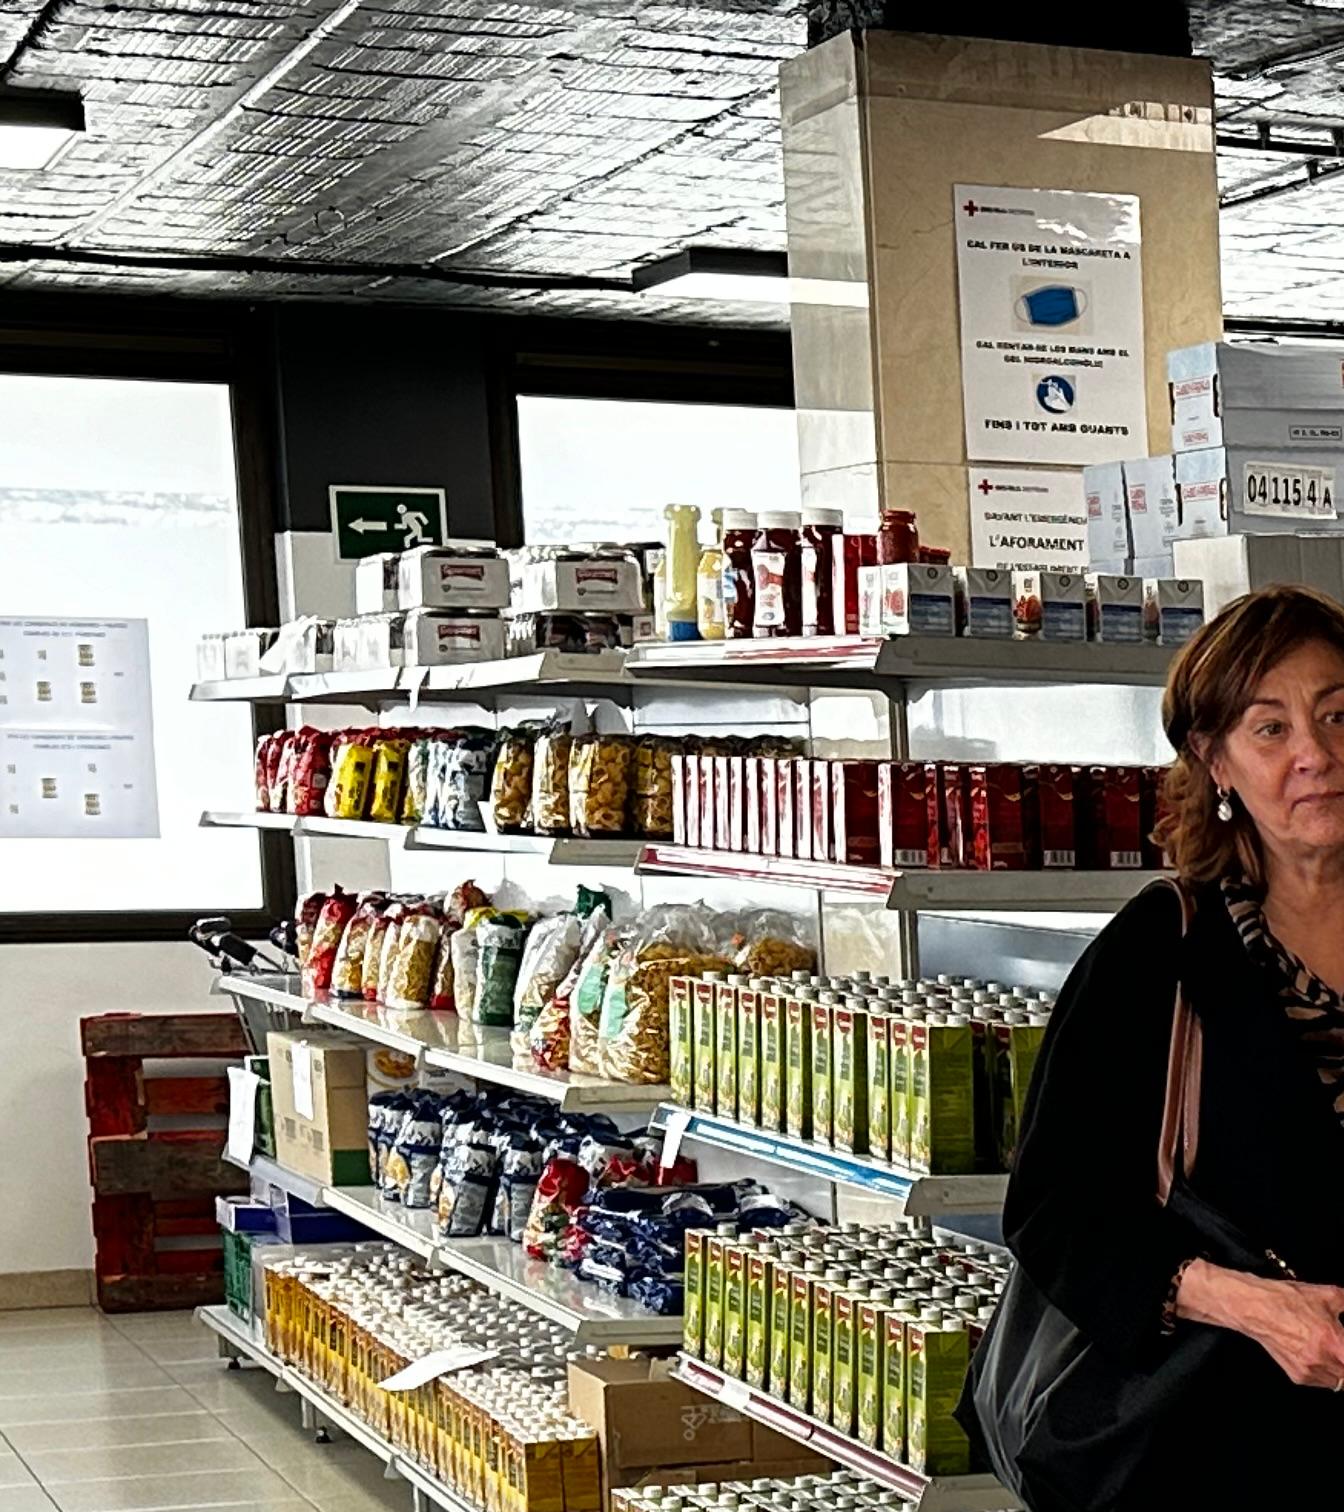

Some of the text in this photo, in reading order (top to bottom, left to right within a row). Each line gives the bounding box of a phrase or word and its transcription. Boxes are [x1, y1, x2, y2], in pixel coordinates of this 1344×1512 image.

[1247, 474, 1267, 503] 04
[1272, 476, 1301, 506] 115
[989, 535, 1085, 552] L'AFORAMENT
